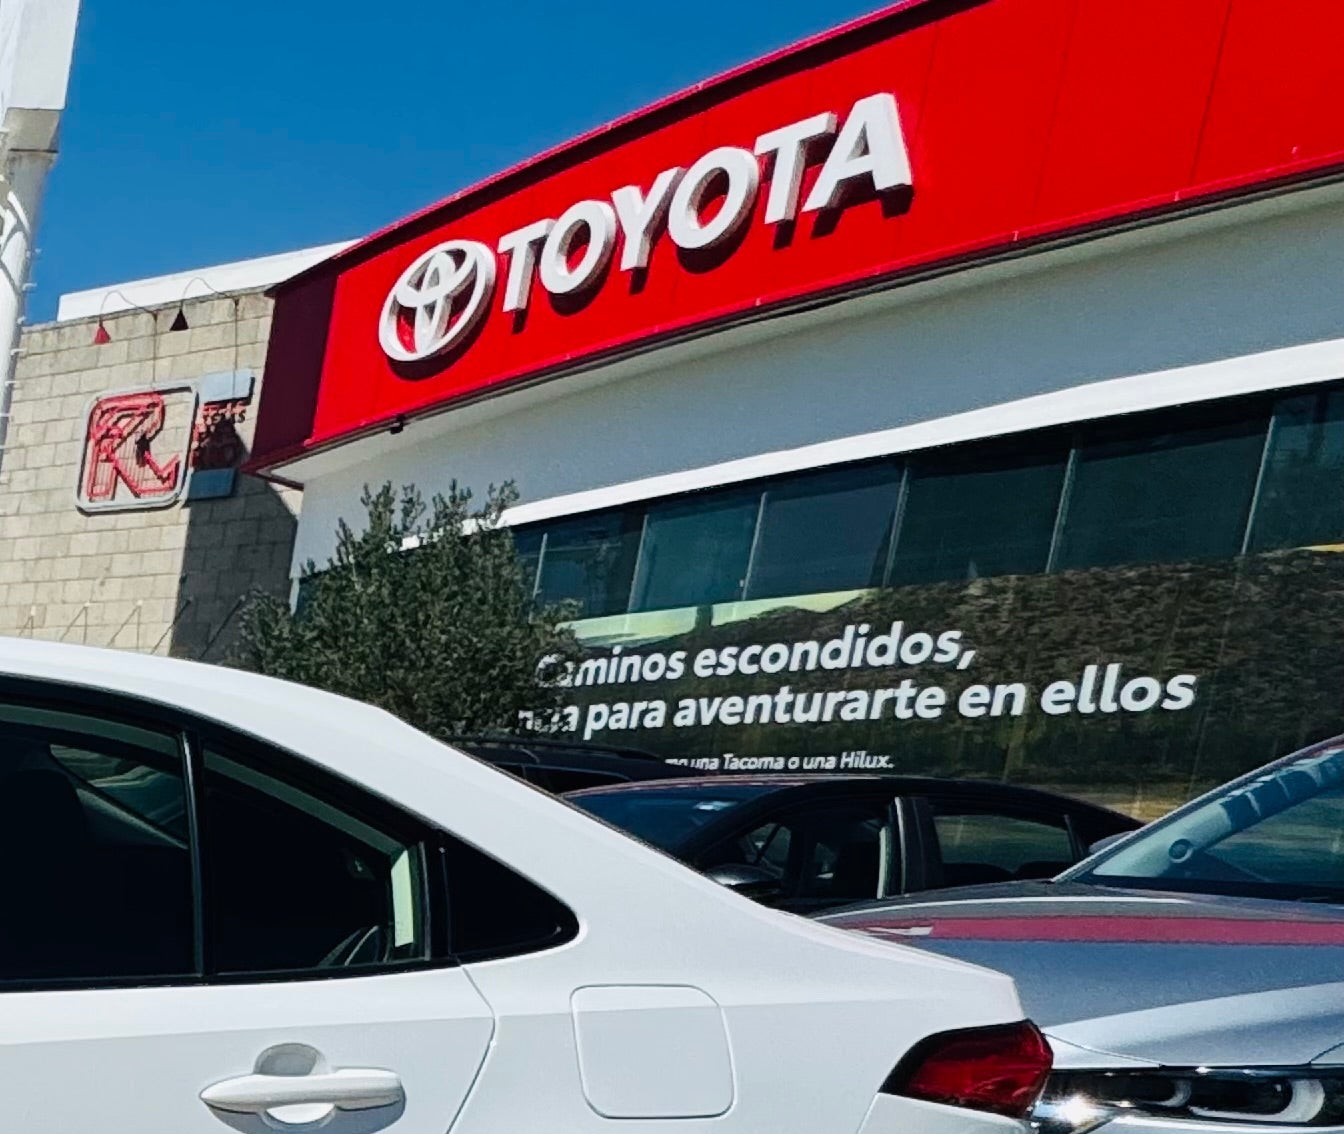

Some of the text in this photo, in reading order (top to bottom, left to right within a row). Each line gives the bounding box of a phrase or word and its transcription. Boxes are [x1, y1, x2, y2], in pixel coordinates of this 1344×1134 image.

[497, 92, 913, 313] TOYOTA
[693, 620, 976, 678] escondidos,
[582, 699, 667, 741] para
[672, 678, 947, 729] aventurarte
[958, 682, 1027, 718] en
[1040, 662, 1198, 715] ellos
[722, 752, 786, 770] Tacoma
[787, 758, 799, 770] o
[802, 755, 836, 770] una
[839, 750, 895, 769] Hilux.
